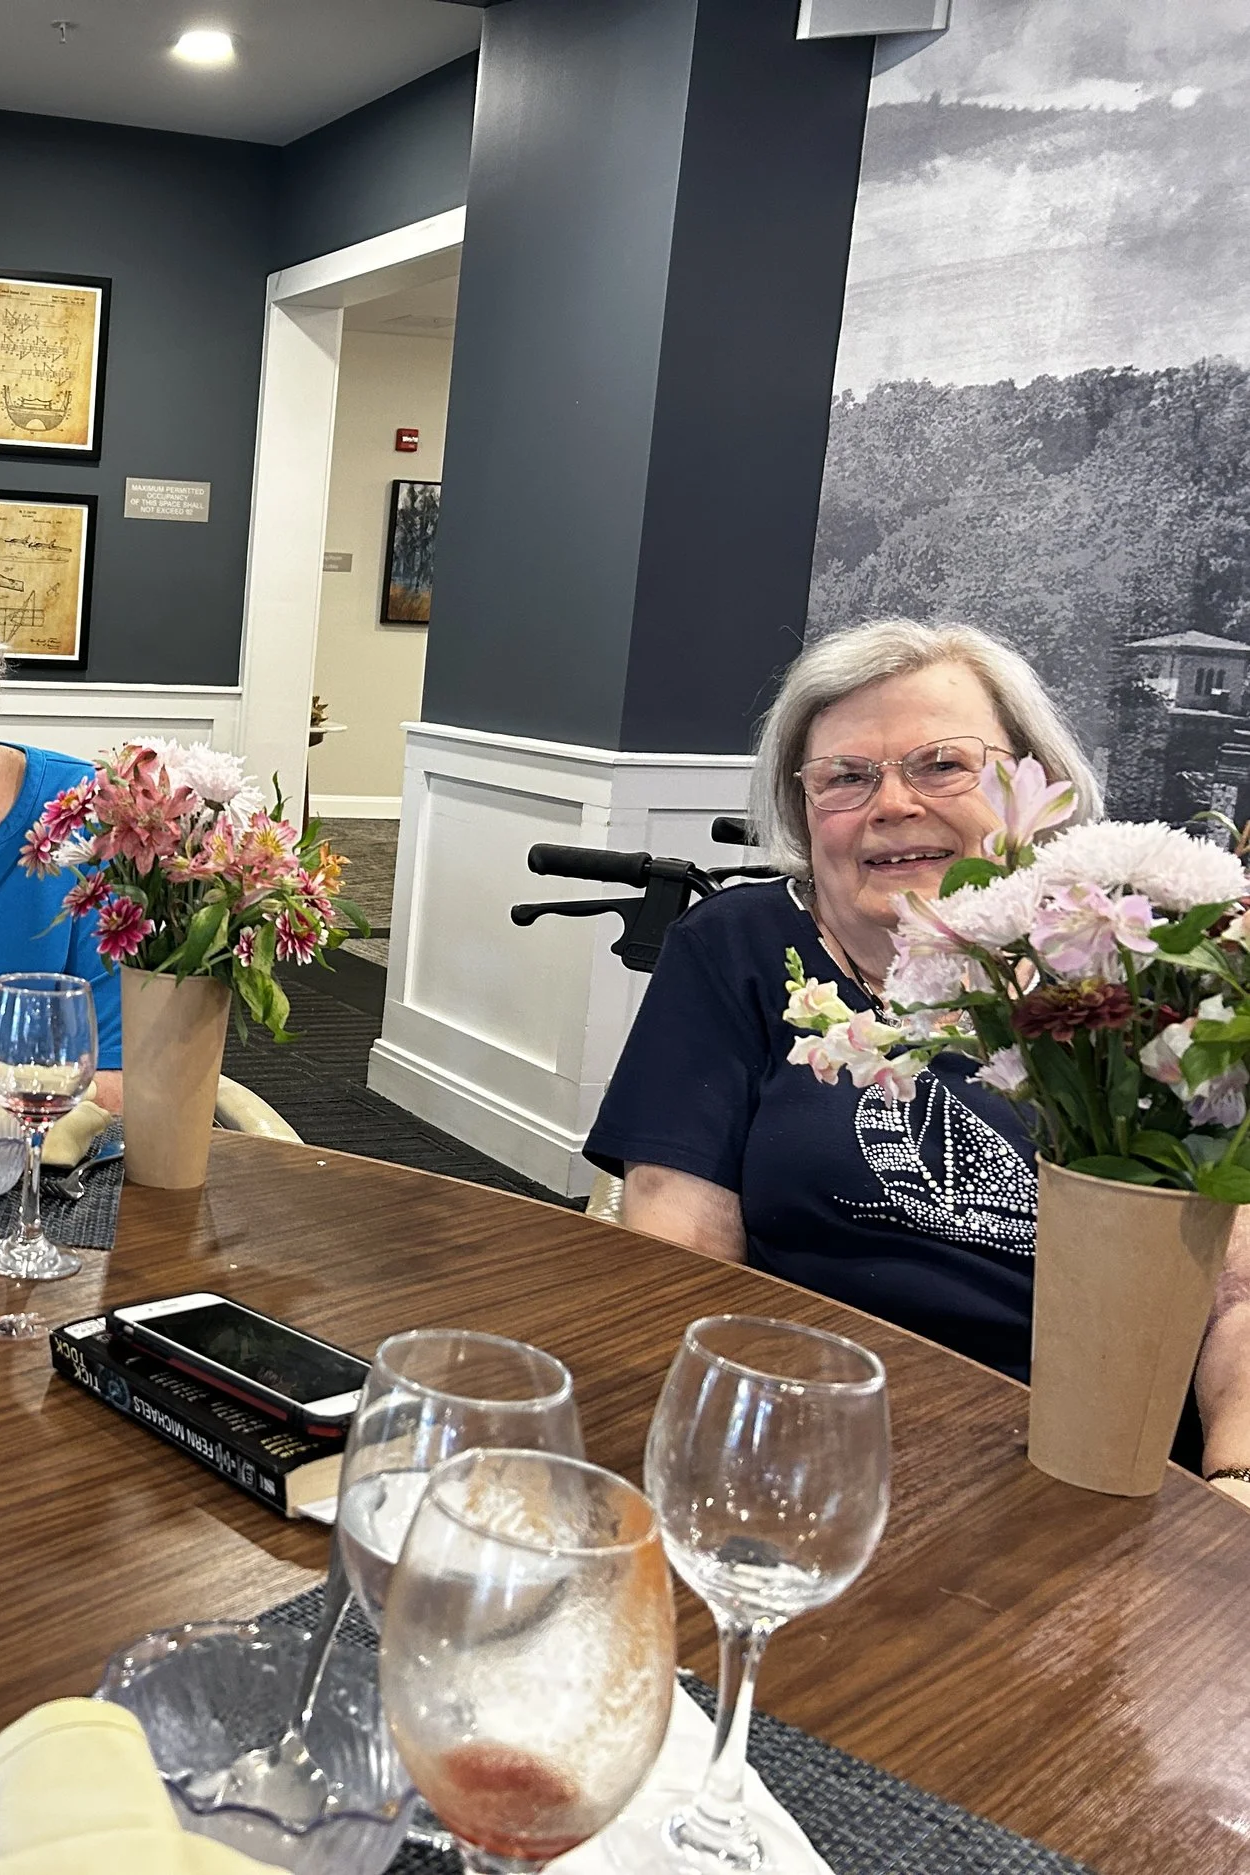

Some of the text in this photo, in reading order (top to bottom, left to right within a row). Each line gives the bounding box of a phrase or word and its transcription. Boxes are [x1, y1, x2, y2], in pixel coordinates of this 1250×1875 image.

[131, 484, 205, 495] MAXIMUM PERMITTED
[146, 492, 189, 501] OCCUPANCY
[156, 507, 184, 515] EXCEED
[158, 500, 181, 508] SPACE
[183, 501, 204, 509] SHALL
[54, 1336, 87, 1369] TOCK
[73, 1362, 101, 1393] TICK
[133, 1395, 185, 1441] MICHAELS
[186, 1428, 214, 1459] FERN
